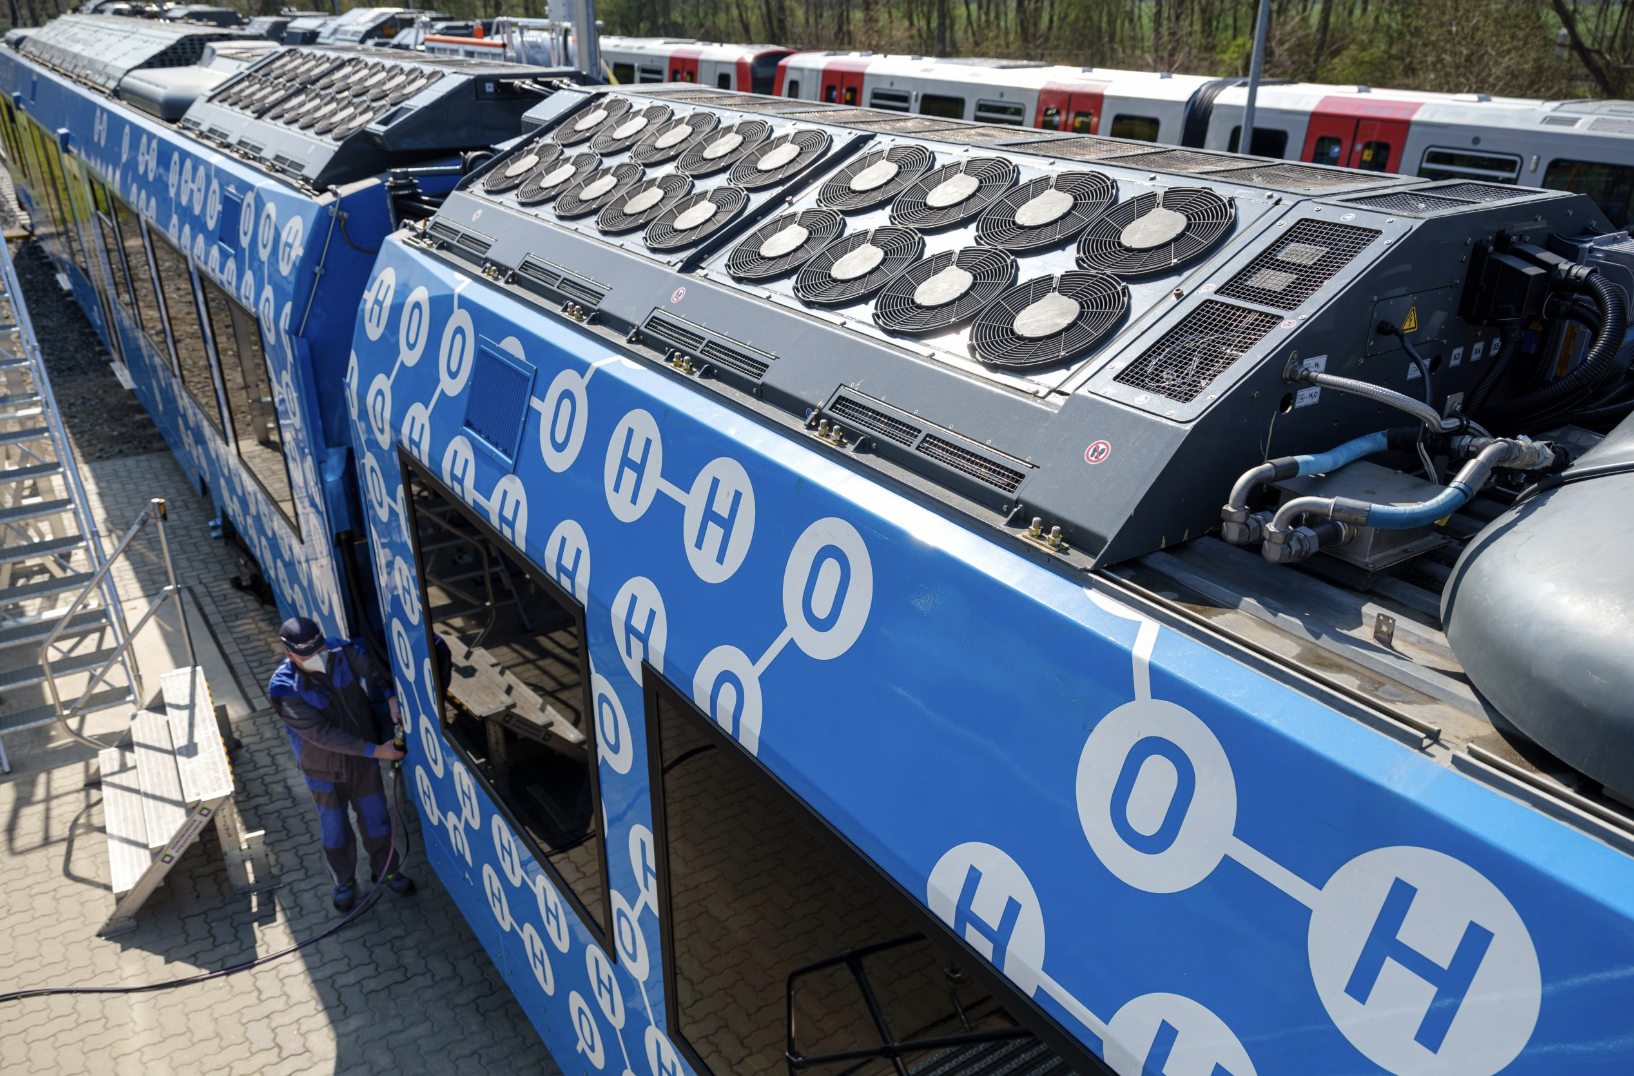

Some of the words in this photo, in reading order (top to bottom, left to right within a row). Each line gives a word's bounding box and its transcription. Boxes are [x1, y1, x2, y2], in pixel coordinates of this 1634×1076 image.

[208, 185, 218, 223] O
[243, 201, 253, 237] O
[262, 213, 272, 250] O
[282, 225, 300, 266] H
[262, 297, 272, 335] O
[369, 279, 390, 328] H
[406, 302, 422, 350] O
[446, 326, 466, 380] O
[372, 388, 385, 436] O
[408, 415, 425, 460] H
[550, 389, 576, 453] O
[370, 465, 384, 508] O
[452, 449, 469, 501] H
[613, 426, 652, 506] H
[498, 488, 520, 548] H
[695, 476, 743, 566] H
[398, 566, 415, 617] H
[555, 535, 582, 601] H
[802, 544, 851, 632] O
[396, 630, 410, 670] O
[624, 593, 656, 662] H
[598, 693, 620, 755] O
[709, 670, 744, 743] O
[425, 726, 439, 766] O
[419, 773, 434, 817] H
[458, 771, 475, 821] H
[1110, 736, 1196, 854] O
[497, 824, 516, 878] H
[488, 871, 504, 915] H
[543, 885, 562, 942] H
[954, 864, 1022, 974] H
[529, 931, 547, 985] H
[616, 907, 637, 963] O
[594, 956, 616, 1018] H
[1344, 876, 1495, 1055] H
[577, 1006, 595, 1053] O
